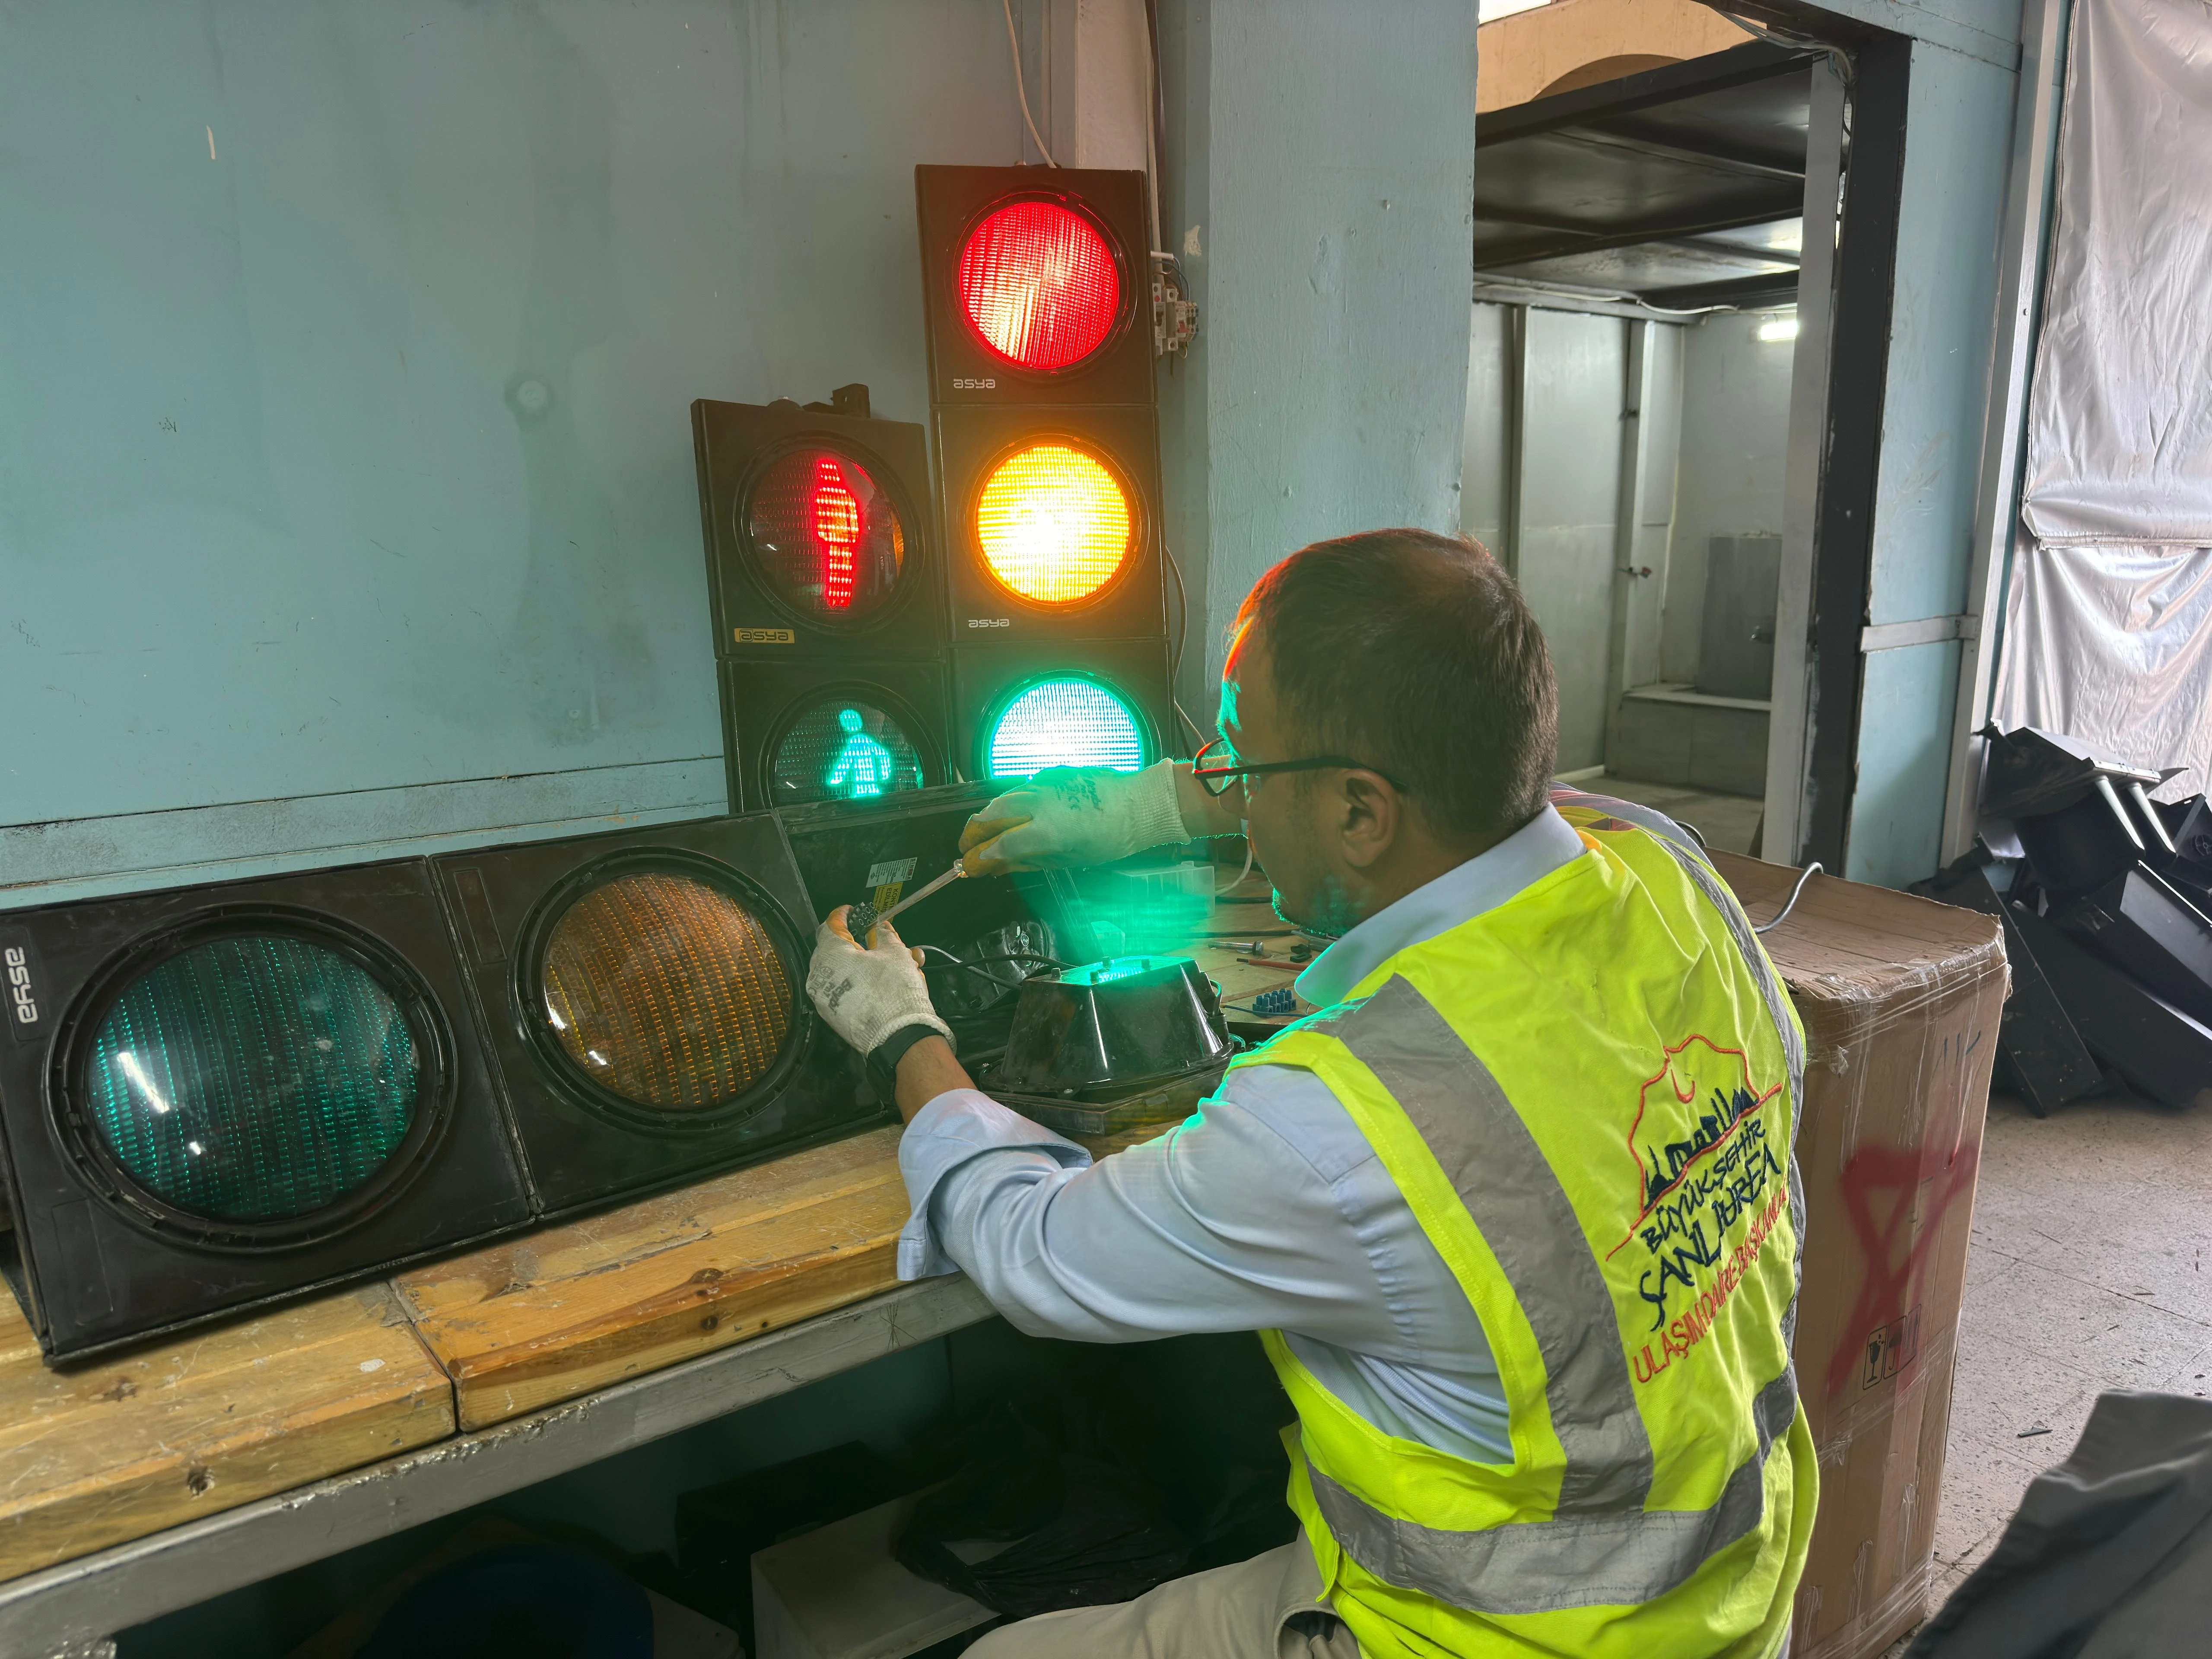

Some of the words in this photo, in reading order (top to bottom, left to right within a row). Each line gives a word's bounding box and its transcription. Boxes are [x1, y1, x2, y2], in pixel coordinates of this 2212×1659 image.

[953, 379, 995, 388] asya
[968, 619, 1010, 628] asya
[739, 629, 788, 642] asya
[5, 947, 38, 1023] asya
